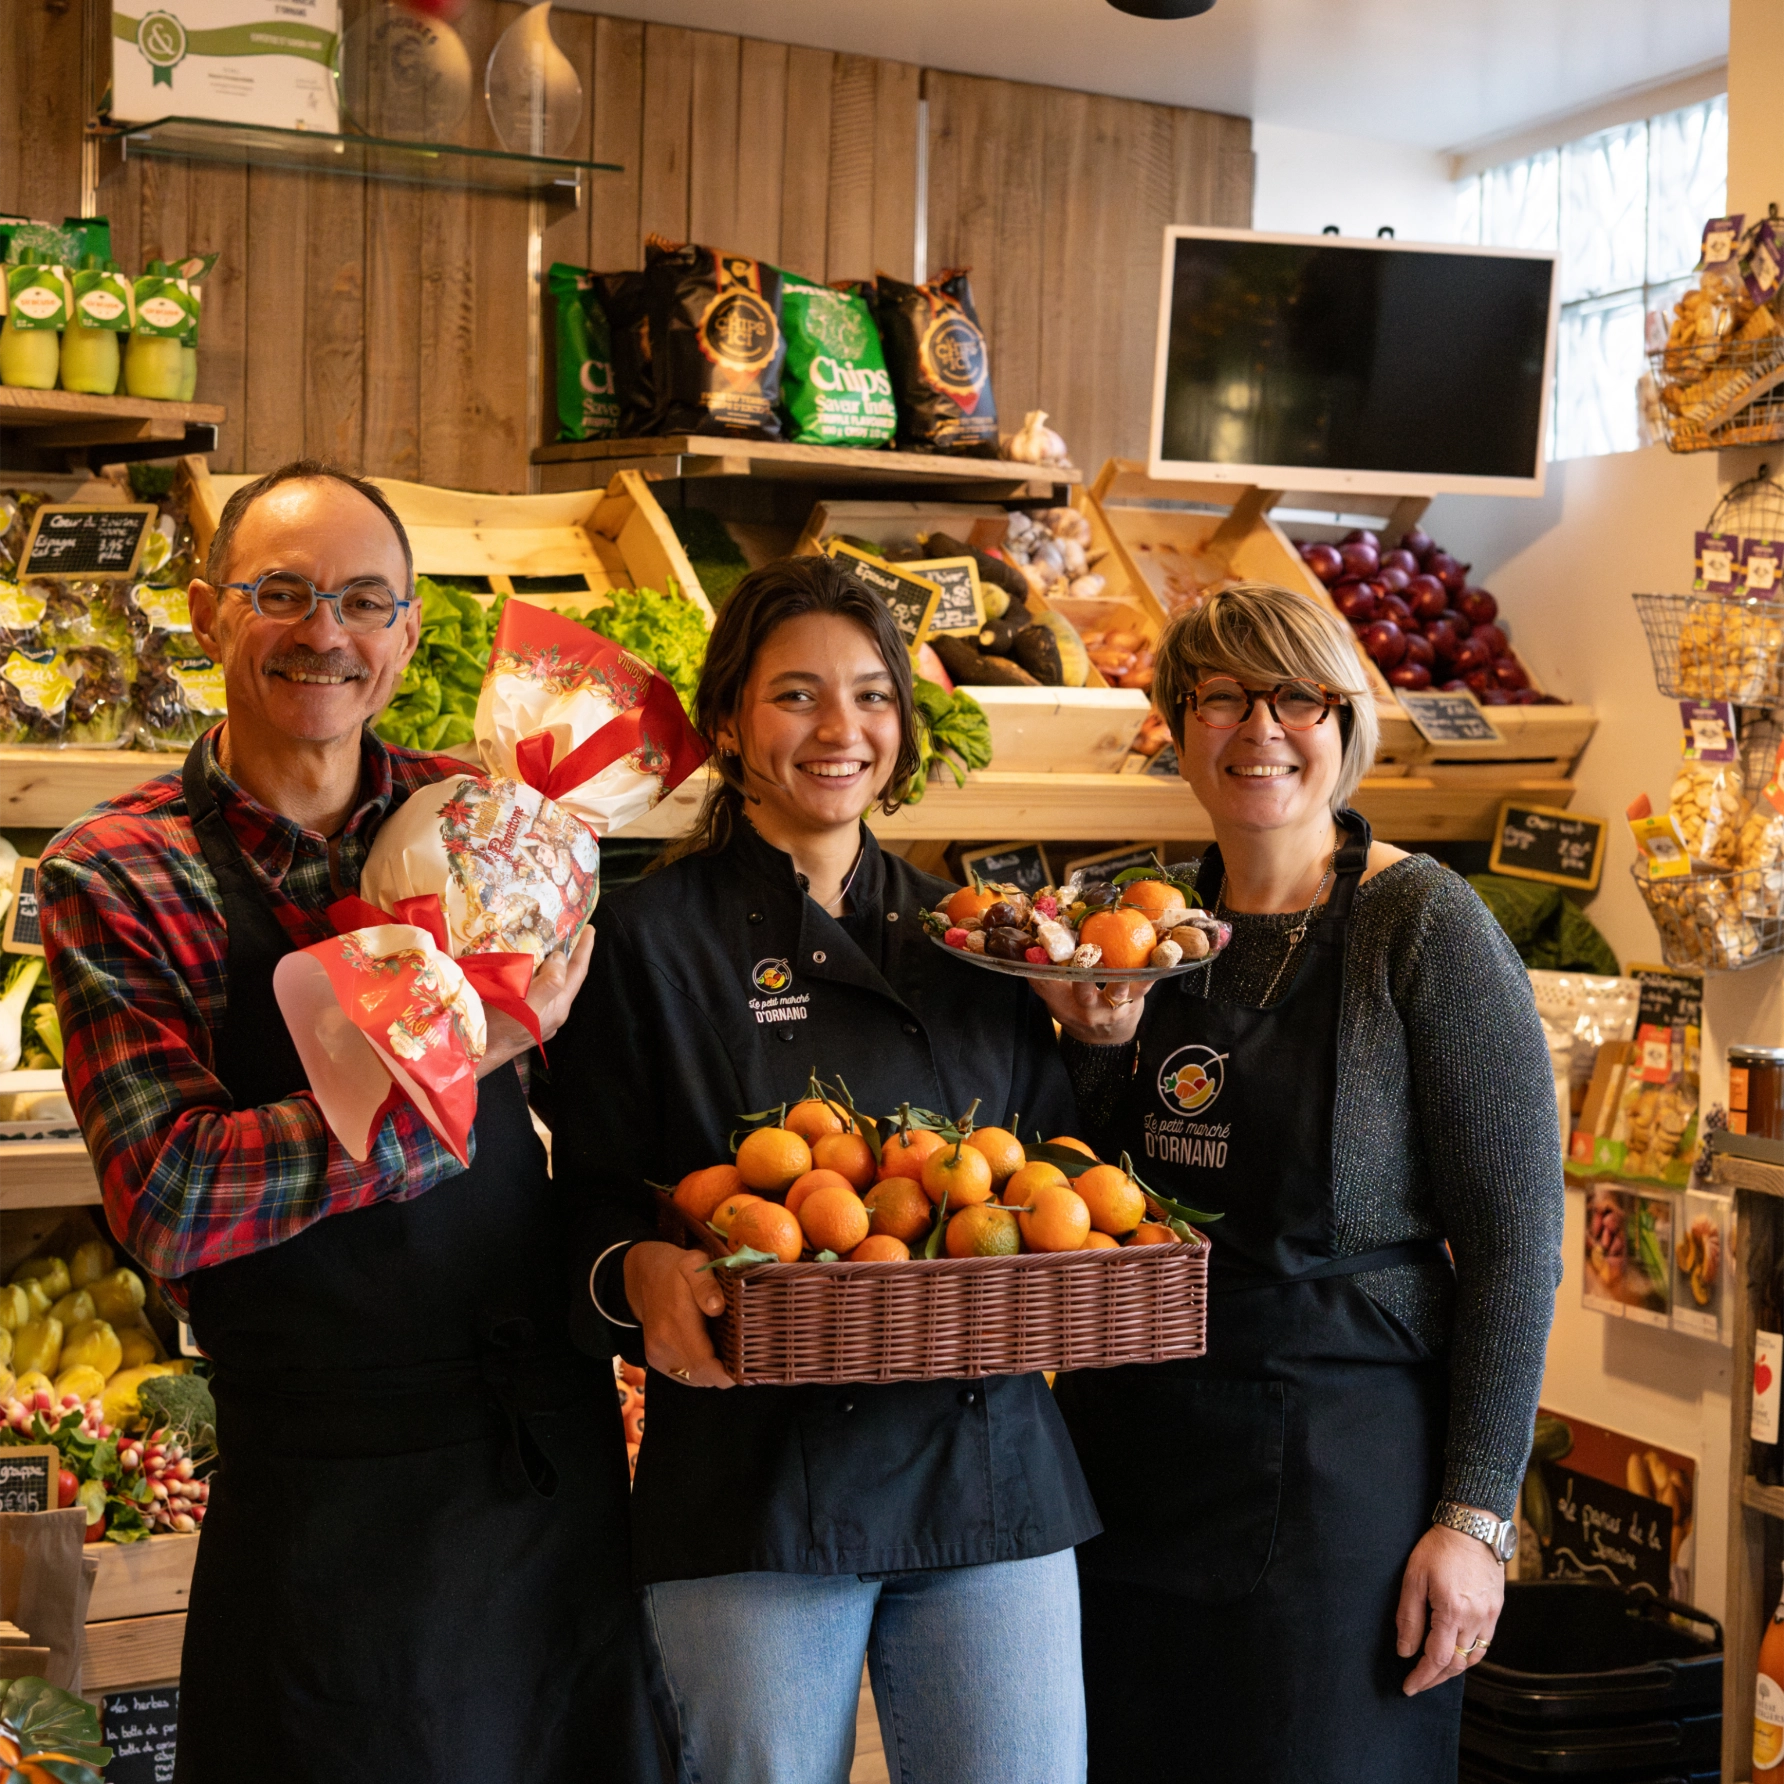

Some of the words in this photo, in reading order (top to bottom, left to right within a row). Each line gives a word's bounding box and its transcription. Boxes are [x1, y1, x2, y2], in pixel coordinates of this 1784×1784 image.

[809, 355, 892, 402] Chips
[617, 653, 650, 698] VIRGINIA
[487, 805, 524, 864] Panettone
[755, 1006, 807, 1023] D'ORNANO
[761, 996, 778, 1010] petit
[780, 993, 810, 1005] marché
[401, 1004, 442, 1049] VIRGINIA
[1144, 1112, 1158, 1134] Le
[1157, 1119, 1184, 1136] petit
[1187, 1123, 1231, 1138] marché
[1144, 1132, 1228, 1169] D'ORNANO
